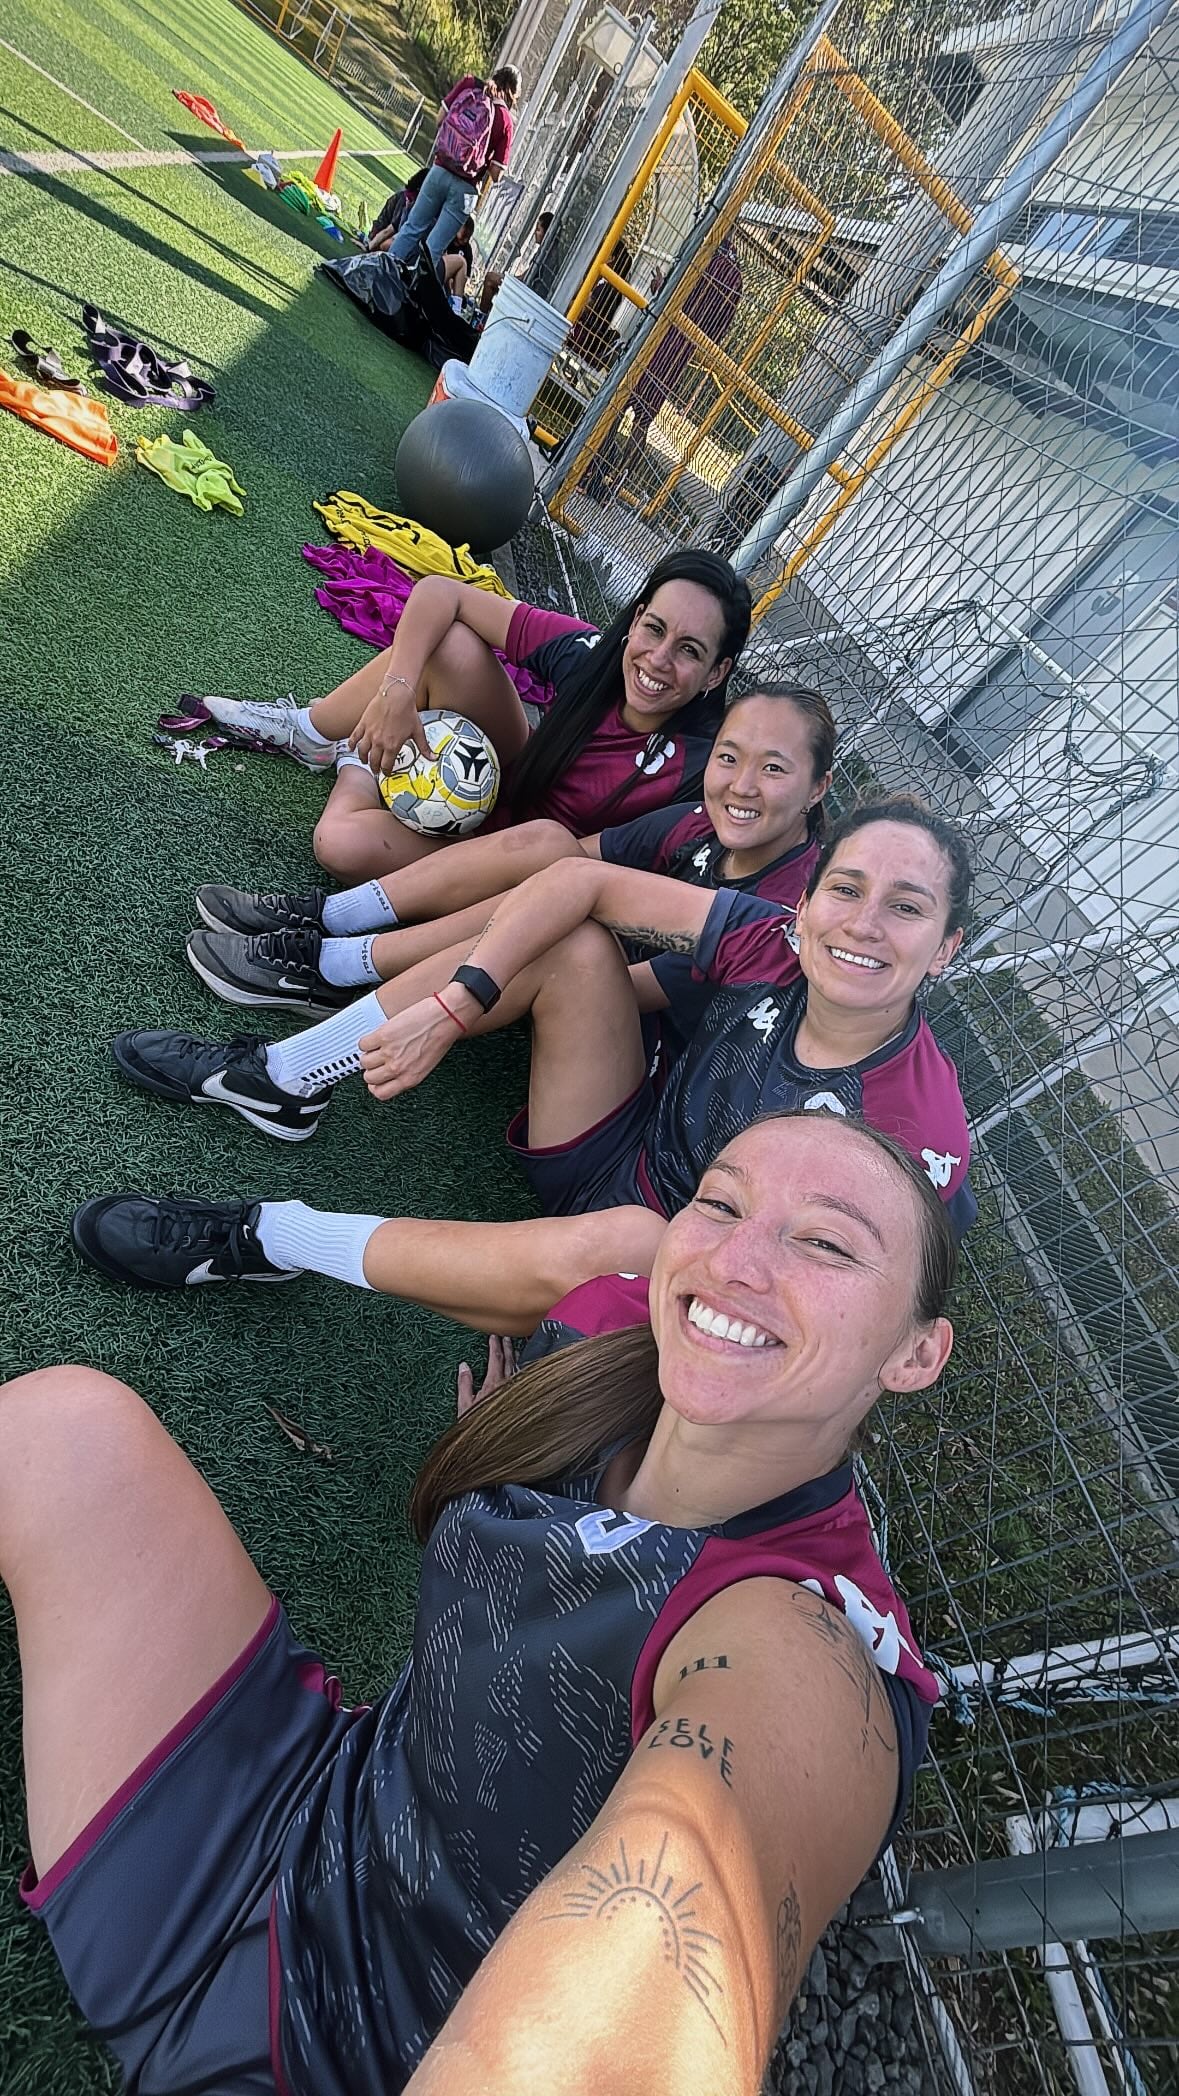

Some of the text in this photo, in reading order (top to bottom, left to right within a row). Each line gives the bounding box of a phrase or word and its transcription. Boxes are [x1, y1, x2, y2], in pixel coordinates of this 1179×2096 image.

[680, 1655, 732, 1682] 111
[658, 1718, 734, 1757] SELF
[648, 1734, 733, 1789] LOVE
